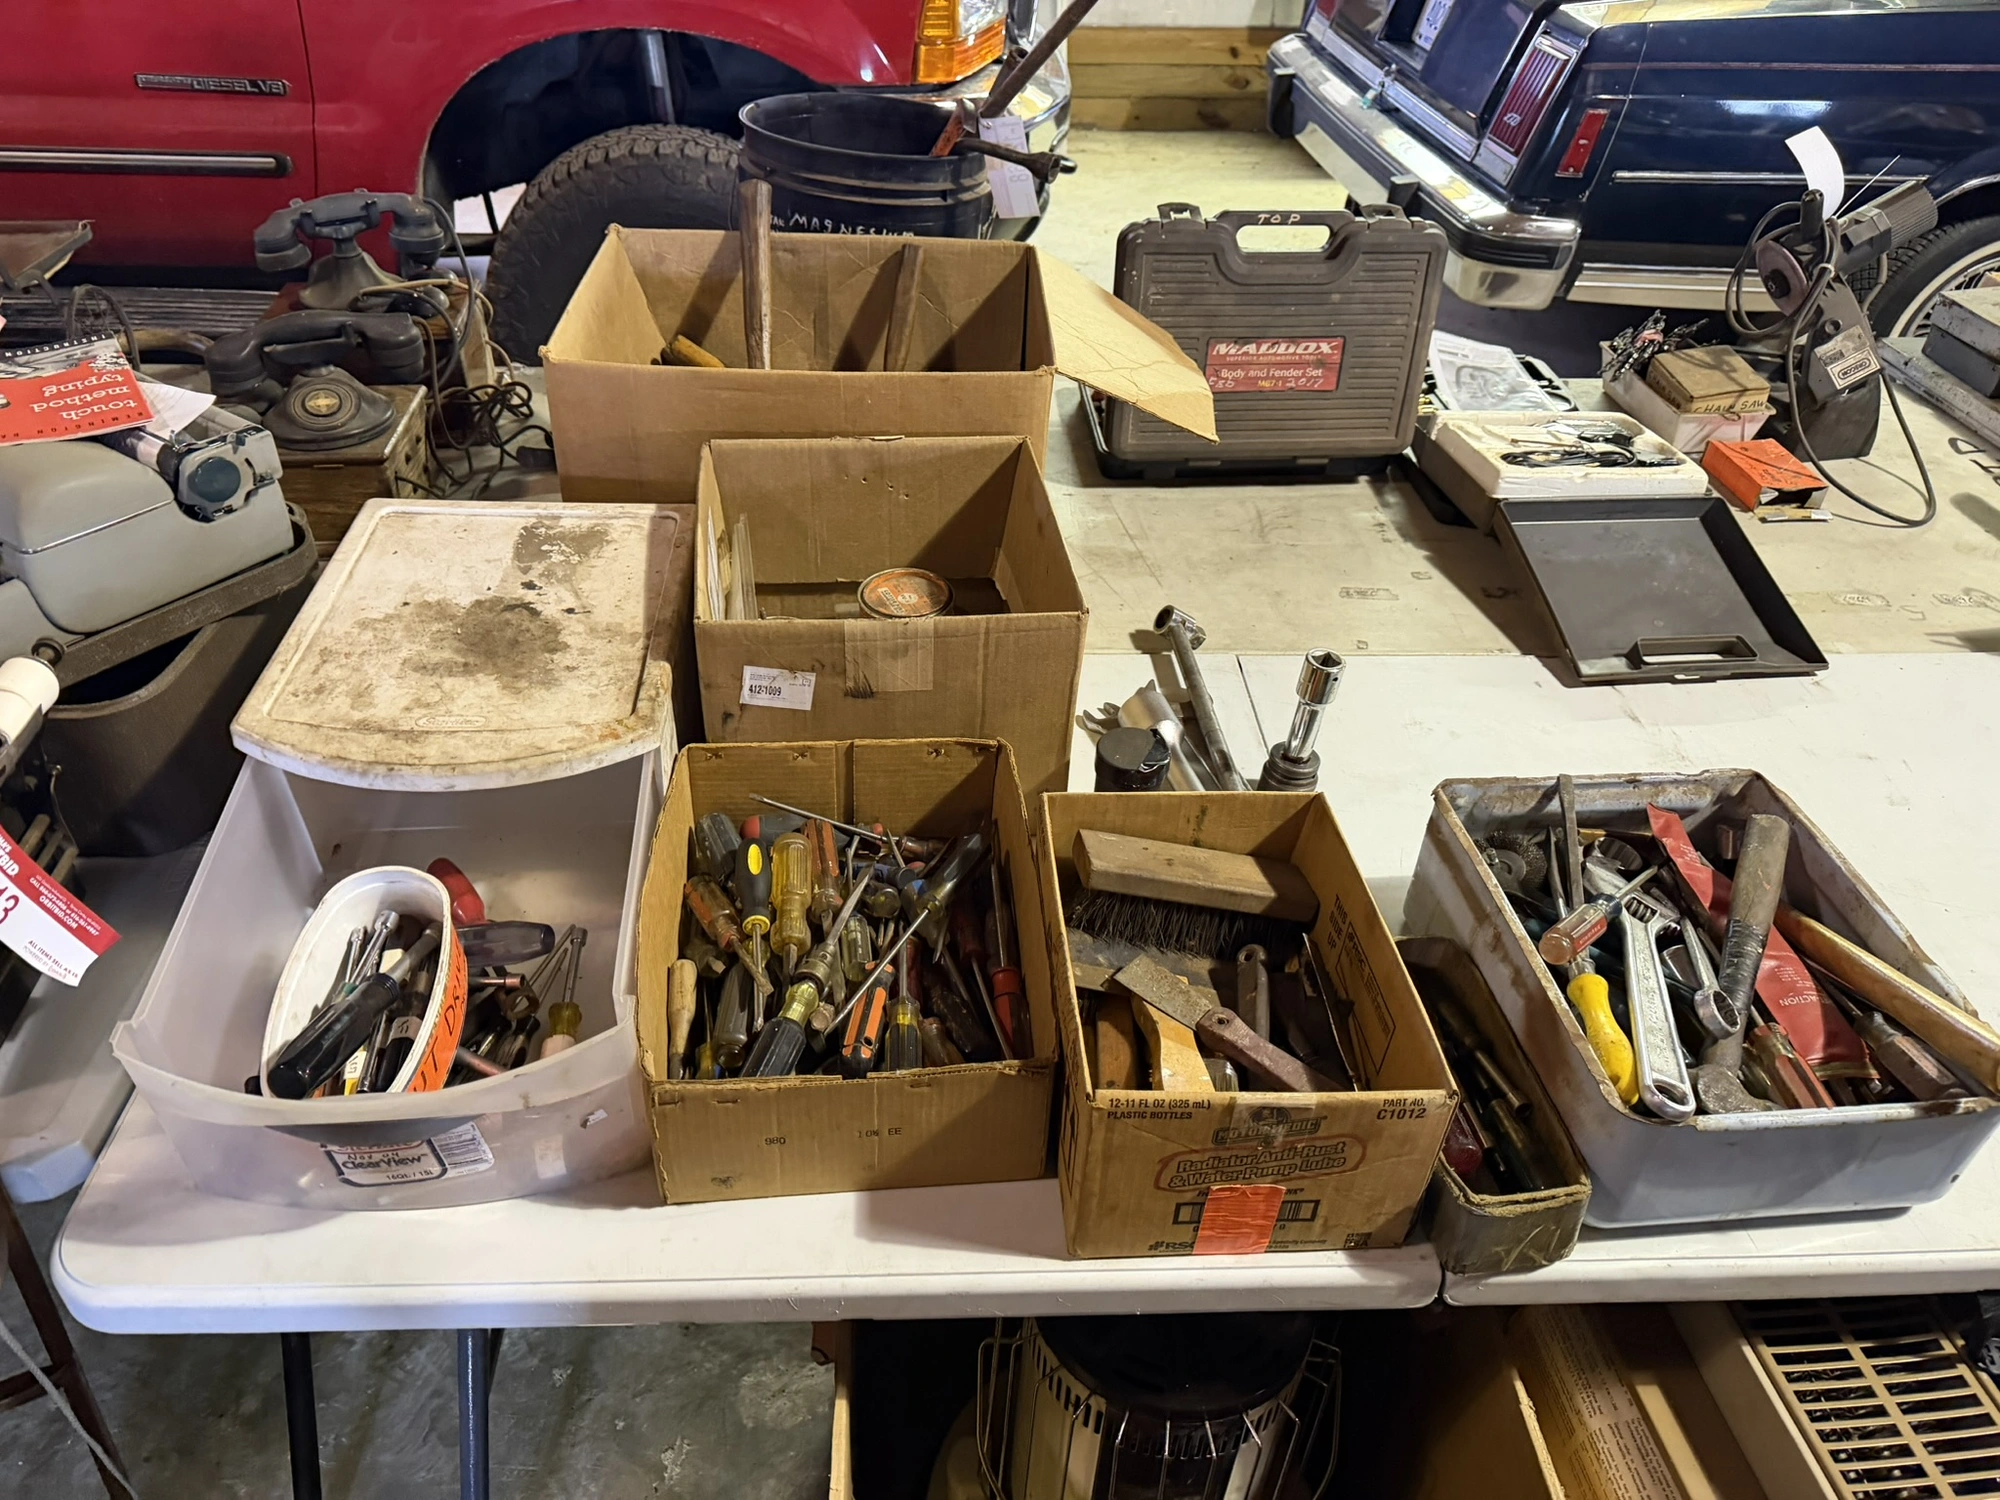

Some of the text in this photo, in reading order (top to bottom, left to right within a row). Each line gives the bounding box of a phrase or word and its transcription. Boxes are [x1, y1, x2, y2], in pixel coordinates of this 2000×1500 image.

[193, 78, 258, 92] DIESEL
[259, 80, 284, 94] V8
[1258, 214, 1301, 225] TOP
[5, 334, 106, 357] INSTRUCTION
[1212, 342, 1338, 355] MADDOX
[1221, 367, 1323, 379] Body and Fender Set
[42, 372, 125, 398] typing
[1286, 378, 1324, 389] 2017
[29, 385, 131, 413] method
[60, 399, 138, 420] touch
[37, 412, 144, 434] REMINGTON
[748, 684, 782, 697] 412-1009
[39, 895, 78, 930] ORBITBID.COM
[1335, 894, 1348, 925] THIS
[1329, 910, 1344, 941] SIDE
[1327, 932, 1337, 950] UP
[28, 939, 39, 950] ALL
[37, 946, 53, 961] ITEMS
[1108, 1098, 1211, 1110] 12-11 FL OZ (325 mL)
[1383, 1098, 1426, 1108] PART NO.
[1107, 1111, 1193, 1120] PLASTIC BOTTLES
[1376, 1107, 1426, 1121] C1012
[888, 1127, 903, 1136] EE
[764, 1136, 786, 1146] 980
[1176, 1142, 1347, 1174] Radiator Anti-Rust
[1168, 1156, 1347, 1188] & Water Pump Lube
